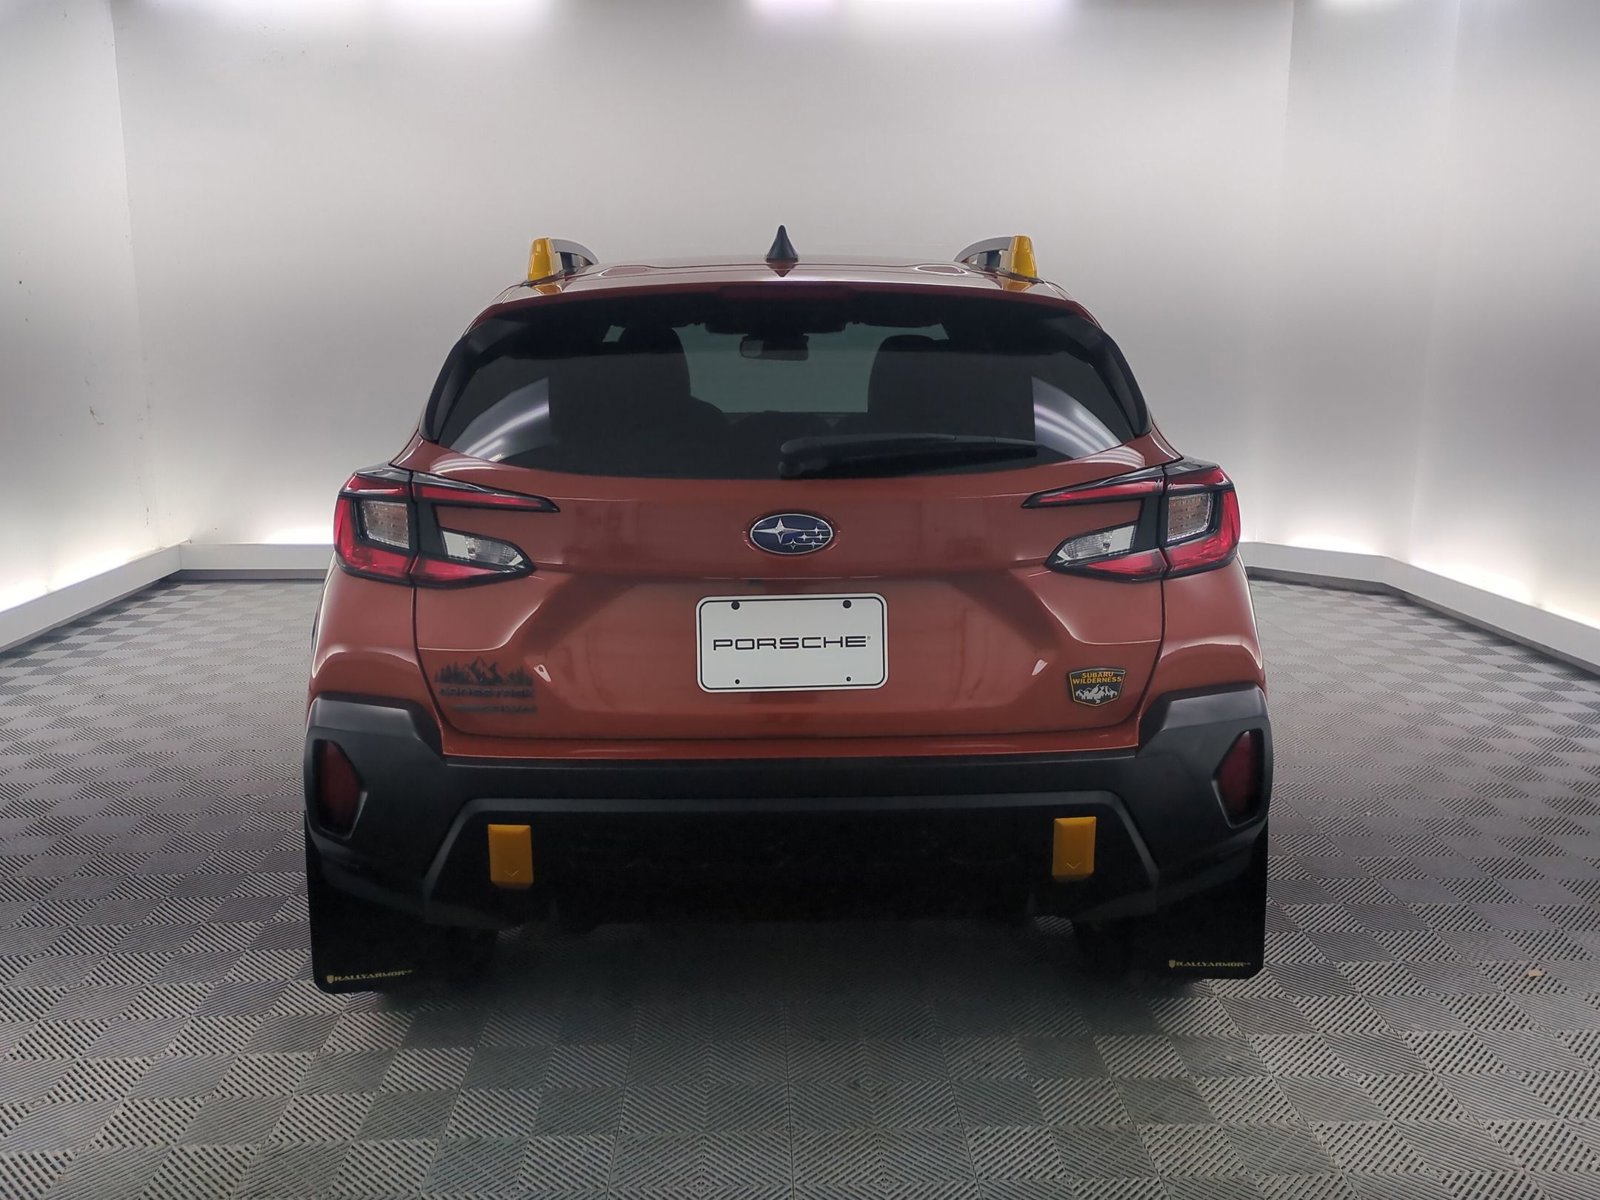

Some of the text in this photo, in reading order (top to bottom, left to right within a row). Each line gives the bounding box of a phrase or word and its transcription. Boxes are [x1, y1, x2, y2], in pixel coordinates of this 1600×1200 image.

[713, 635, 867, 651] PORSCHE
[1082, 671, 1114, 679] SUBARU
[1072, 676, 1122, 685] WILDERNESS
